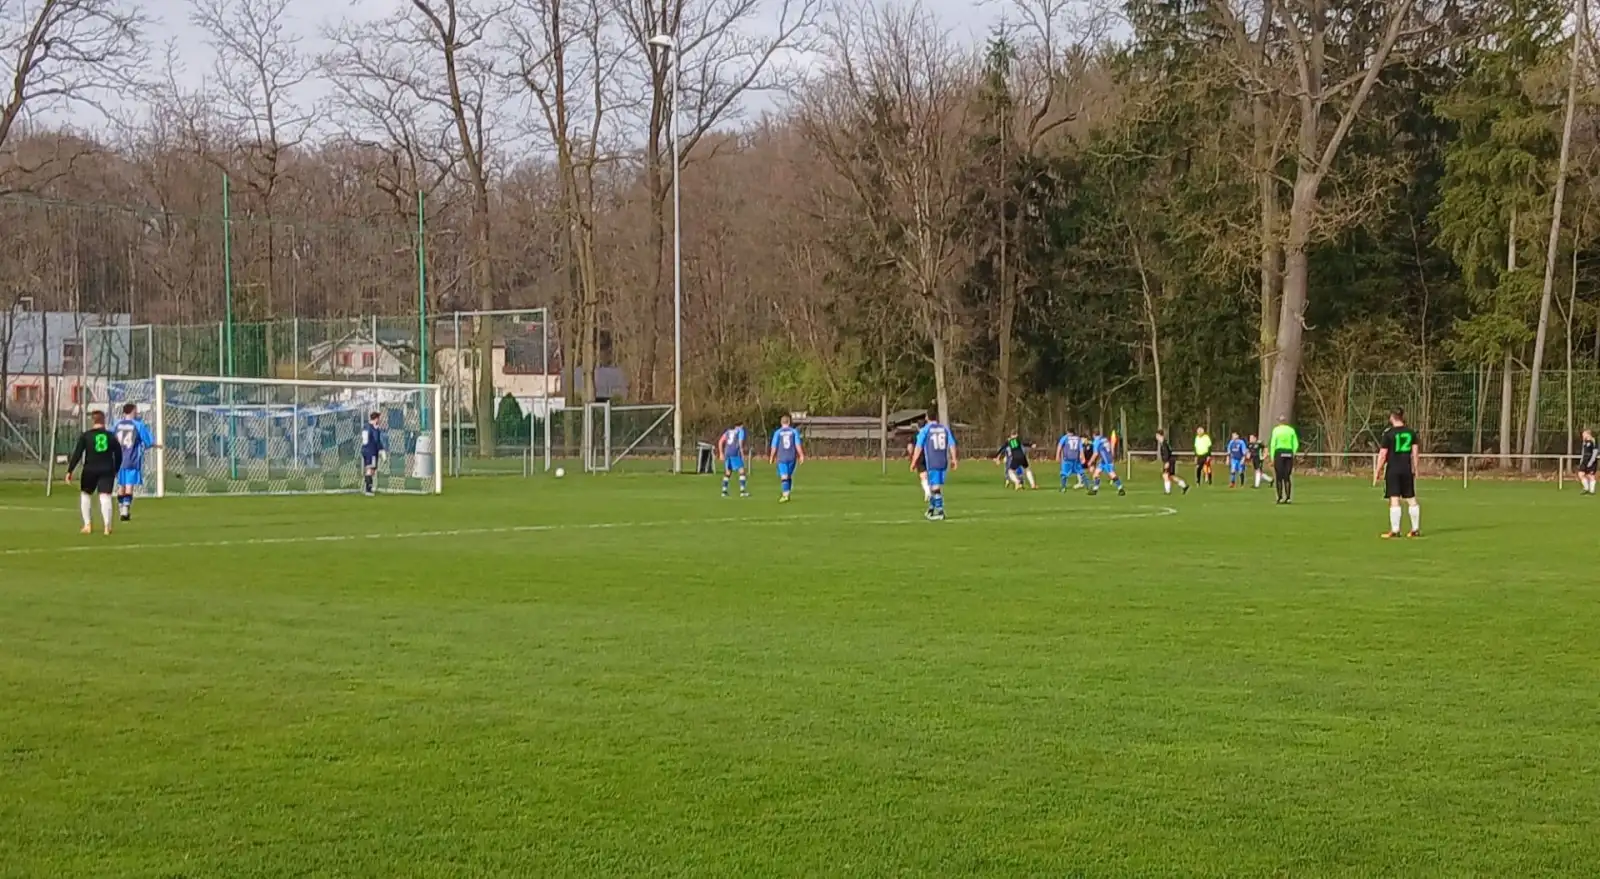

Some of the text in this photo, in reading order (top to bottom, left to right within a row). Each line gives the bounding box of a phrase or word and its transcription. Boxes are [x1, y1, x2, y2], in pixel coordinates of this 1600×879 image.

[95, 433, 108, 452] 8
[117, 430, 132, 448] 14
[1395, 433, 1412, 452] 12
